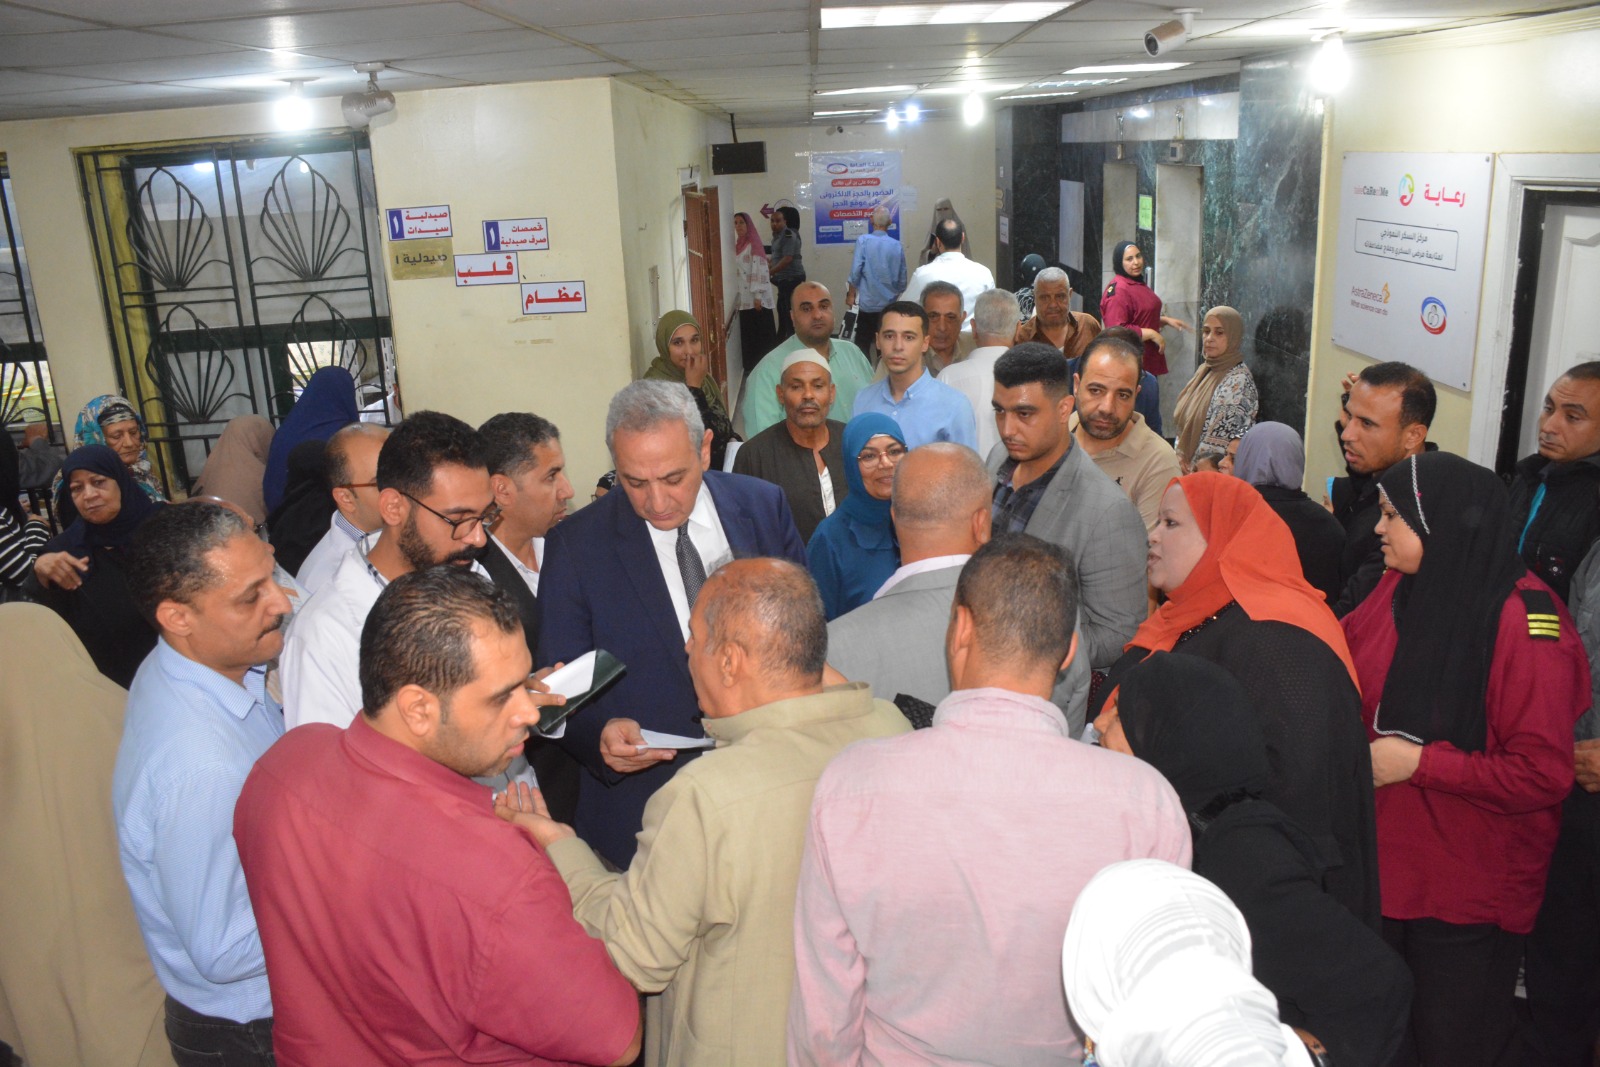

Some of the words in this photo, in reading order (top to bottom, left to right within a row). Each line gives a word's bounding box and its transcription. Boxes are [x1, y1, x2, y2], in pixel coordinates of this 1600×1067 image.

[852, 190, 870, 198] بالحجز
[872, 188, 894, 197] الحضور
[1424, 184, 1465, 208] رعاية
[405, 210, 448, 222] صيدلية
[408, 226, 449, 235] سيدات
[512, 222, 544, 232] تخصصات
[501, 236, 527, 247] صيدلية
[529, 235, 547, 245] صرف
[403, 253, 448, 266] صيدلية
[457, 255, 514, 284] قلب
[525, 286, 583, 311] عظام
[1351, 286, 1382, 302] AstraZeneca
